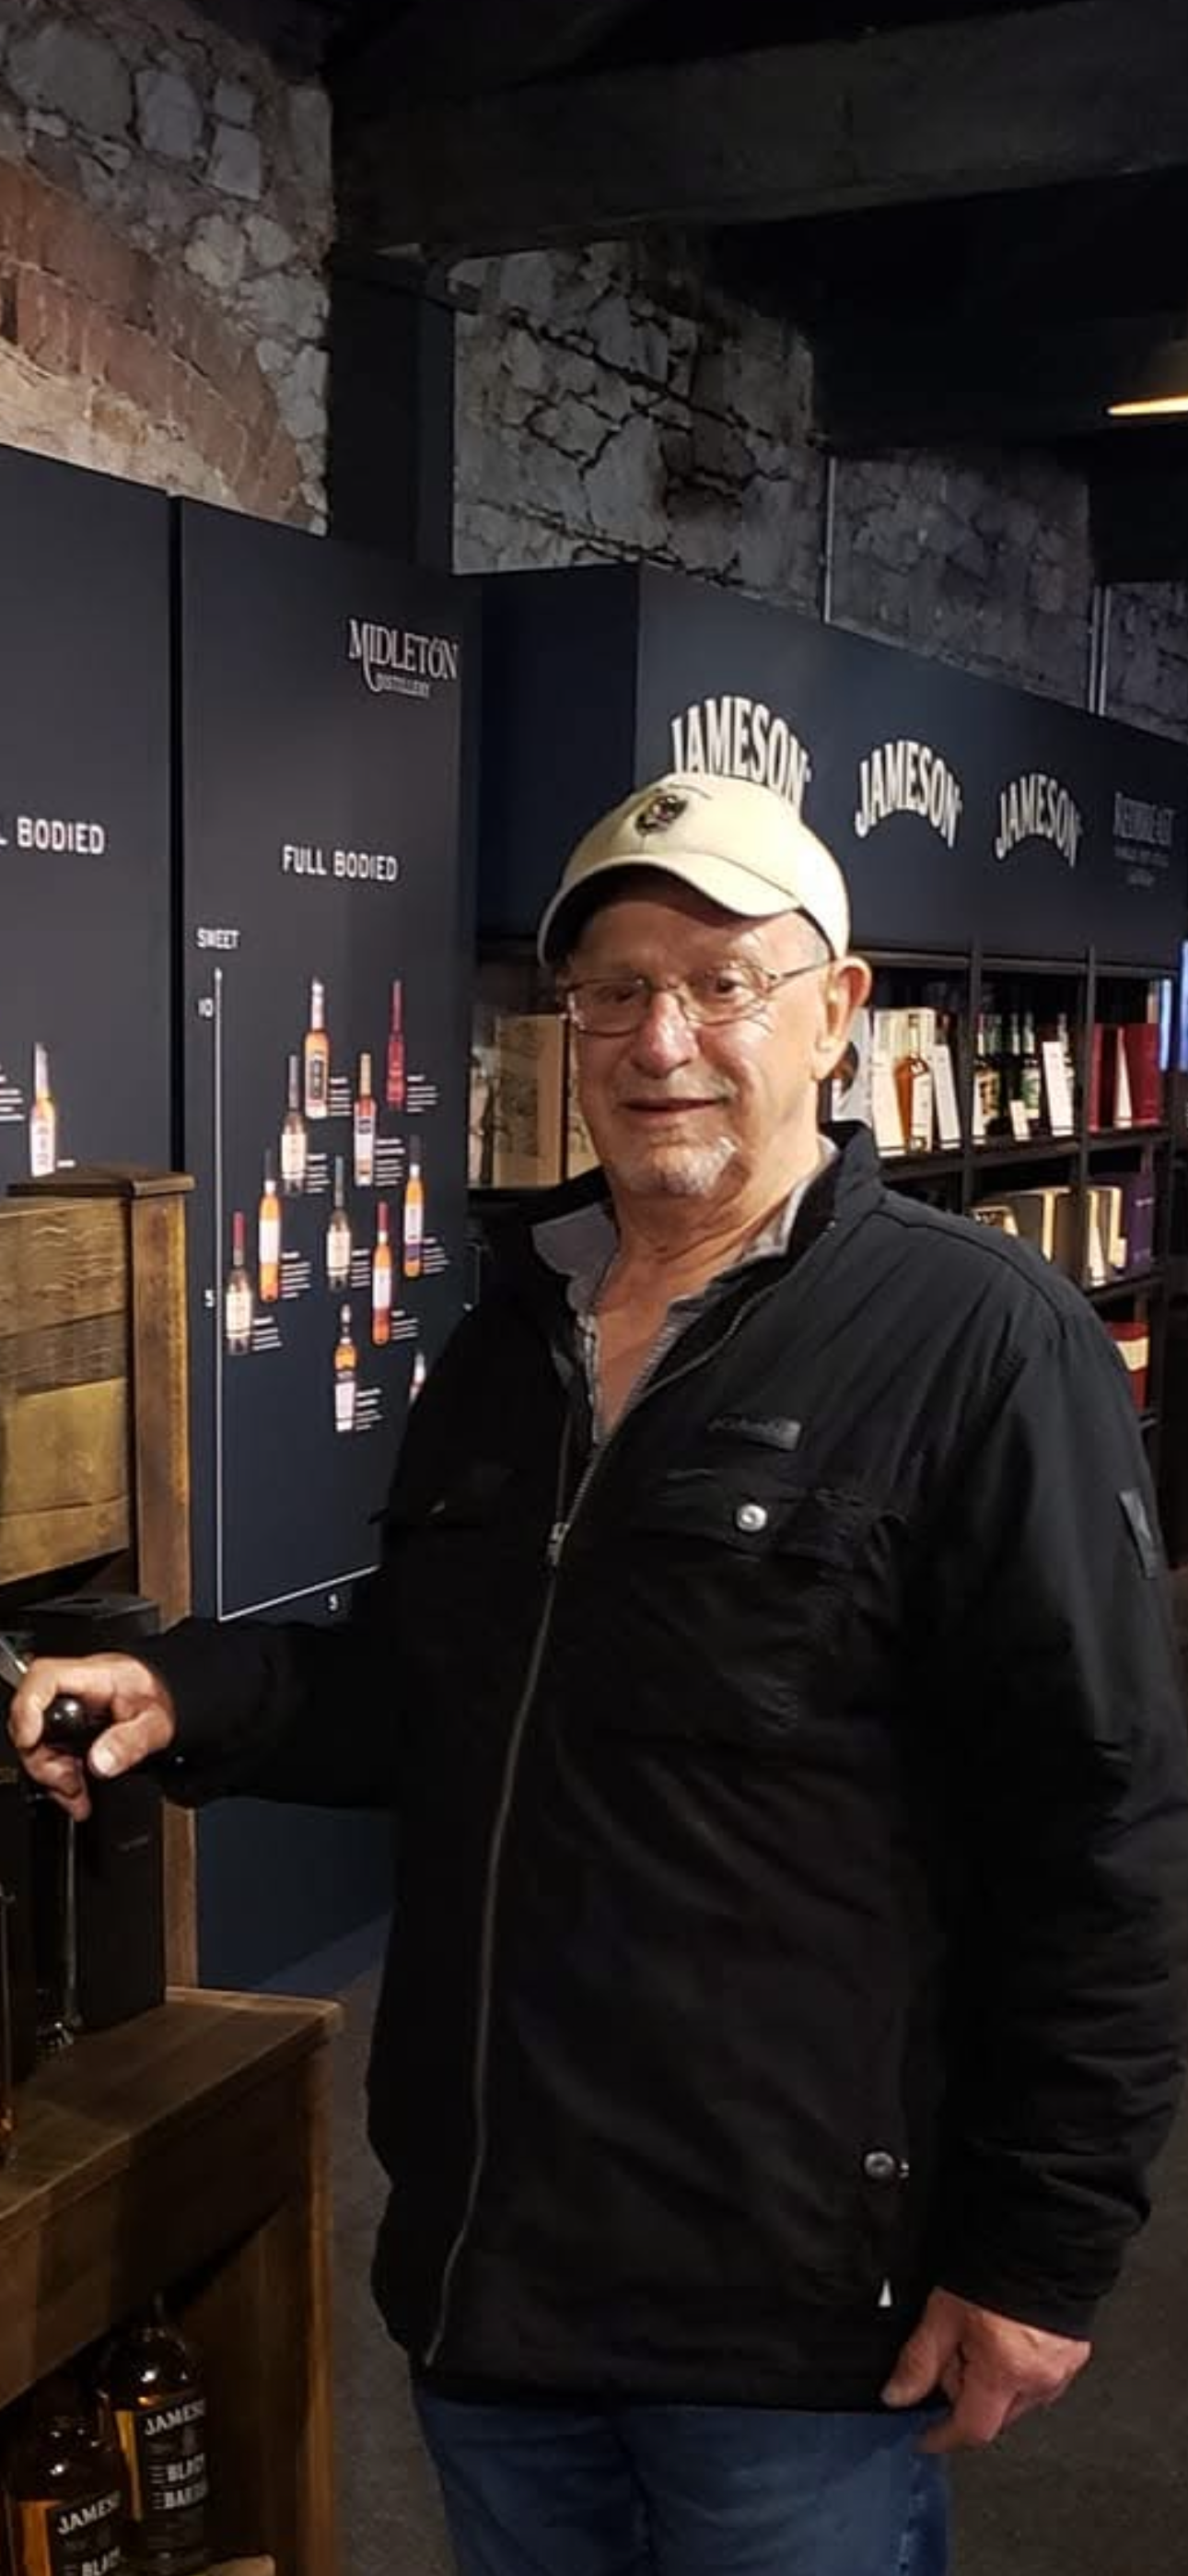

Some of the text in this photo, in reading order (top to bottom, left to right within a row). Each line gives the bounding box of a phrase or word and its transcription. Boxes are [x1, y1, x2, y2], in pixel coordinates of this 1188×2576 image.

[349, 618, 458, 692] MIDLETON
[671, 695, 809, 812] JAMESON
[855, 740, 961, 849] JAMESON
[996, 773, 1081, 867] JAMESON
[17, 815, 105, 854] BODIED
[283, 844, 398, 881] FULL BODIED
[197, 928, 239, 949] SWEET
